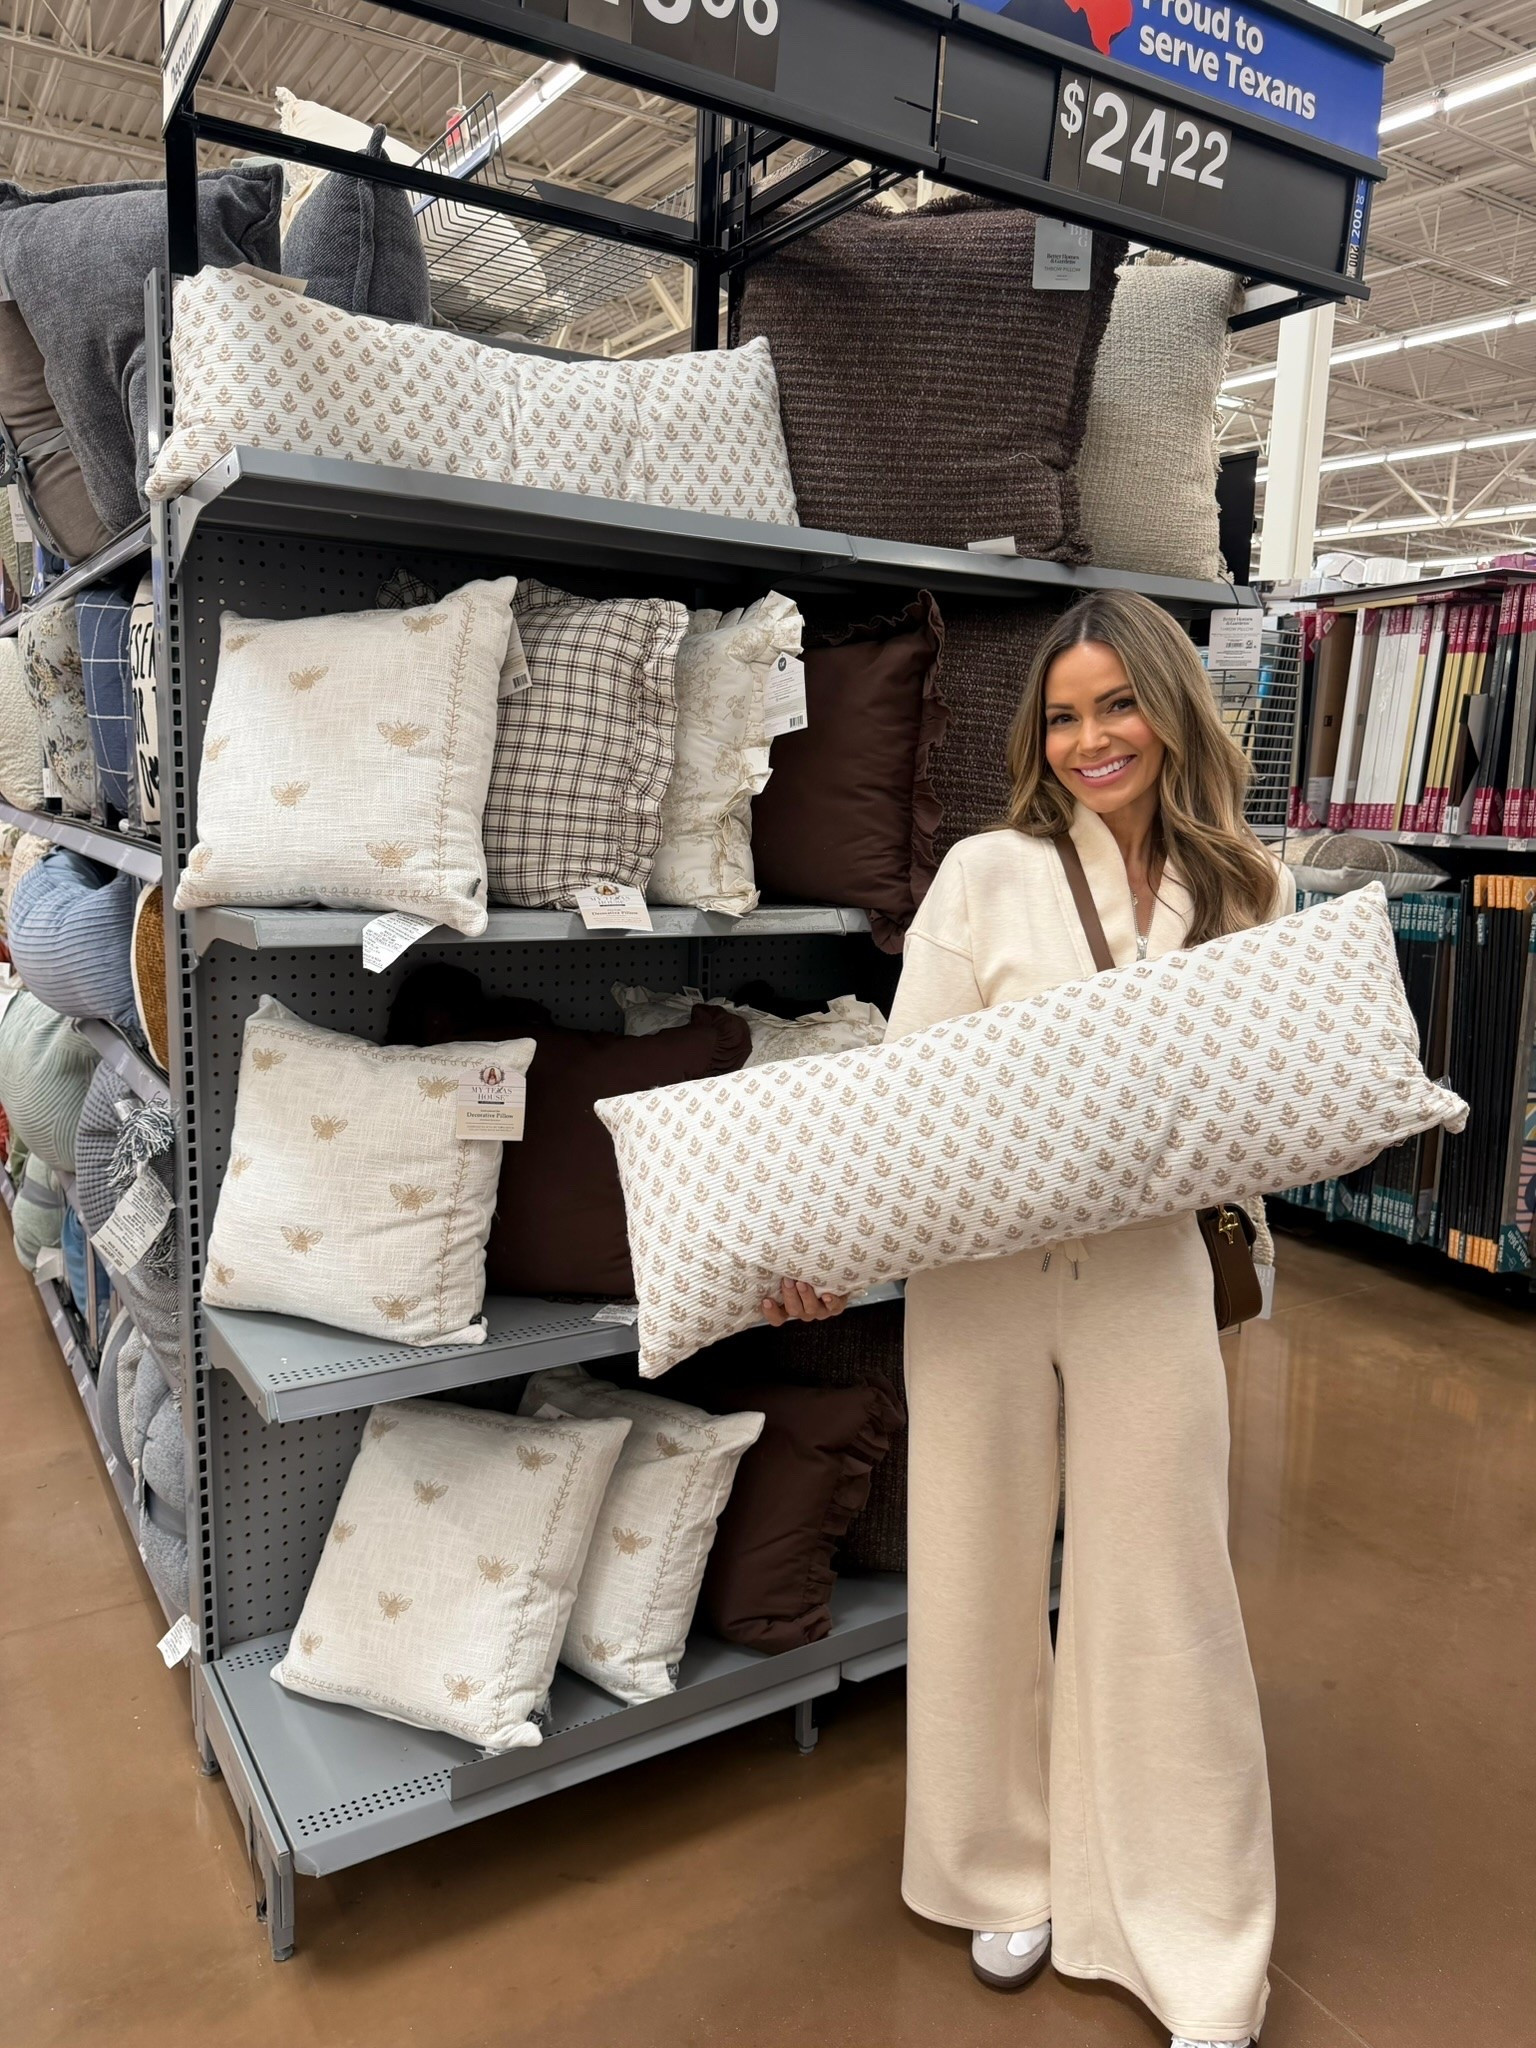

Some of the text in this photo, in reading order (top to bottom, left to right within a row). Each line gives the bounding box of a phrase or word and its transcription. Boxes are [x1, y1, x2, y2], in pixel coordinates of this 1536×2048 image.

[1235, 16, 1264, 55] to
[1139, 25, 1316, 120] serve Texans
